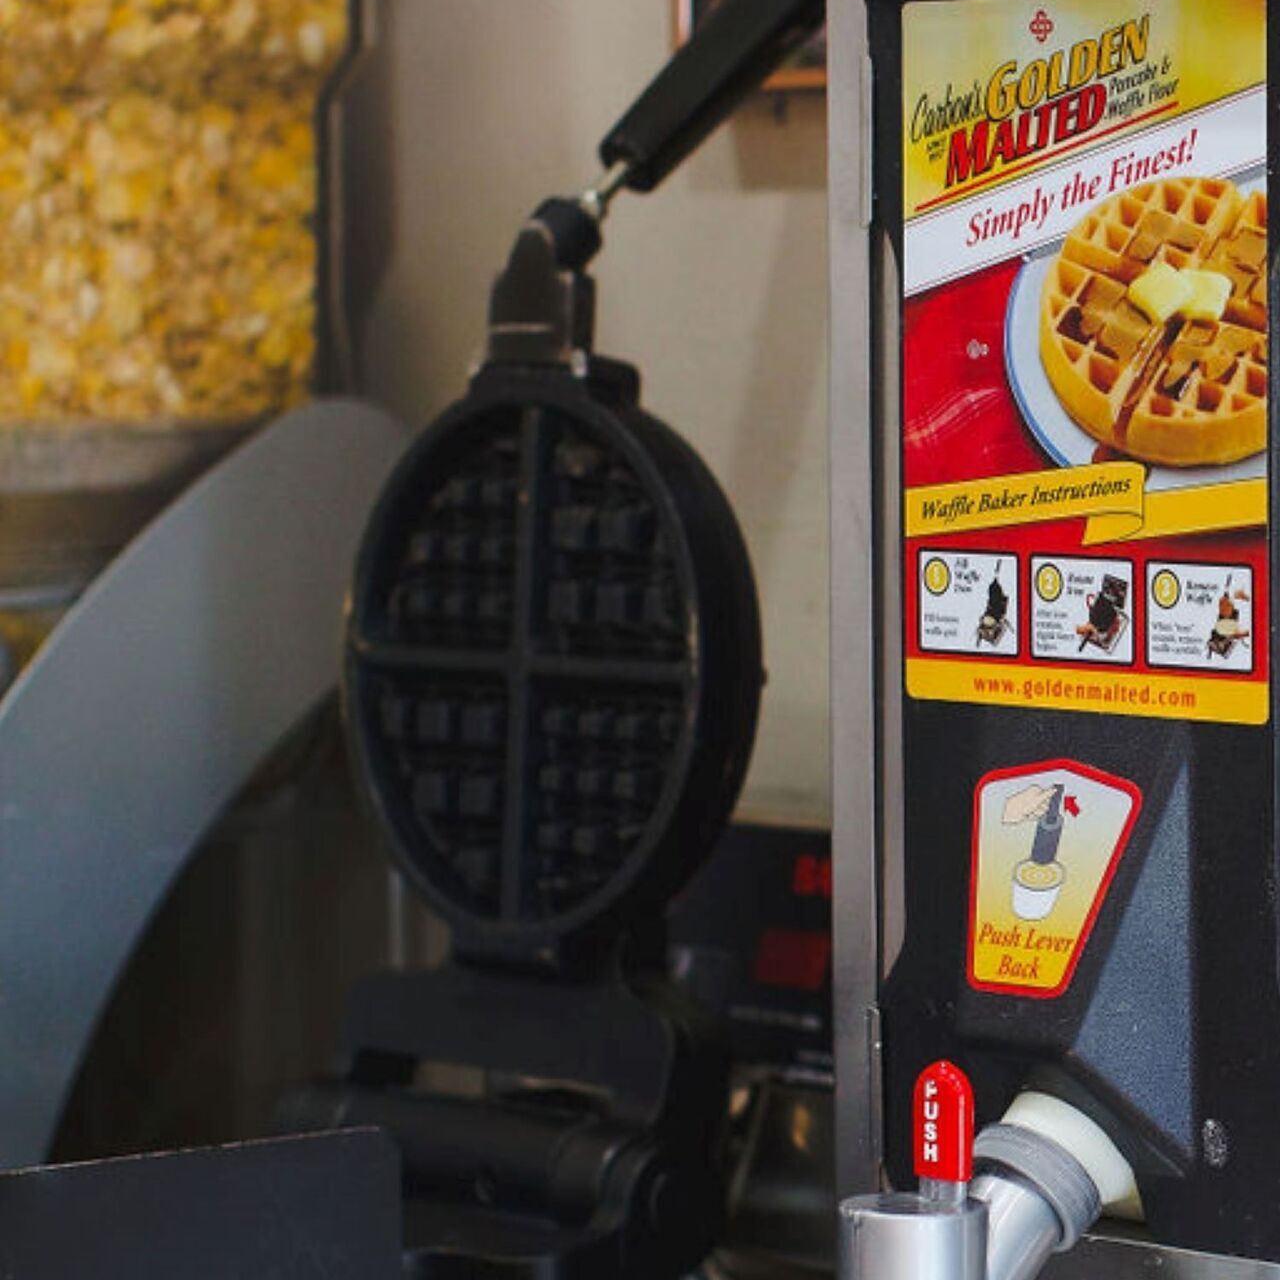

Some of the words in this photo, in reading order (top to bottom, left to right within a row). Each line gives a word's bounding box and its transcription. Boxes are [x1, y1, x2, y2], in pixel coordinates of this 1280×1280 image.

[986, 13, 1151, 121] GOLDEN
[945, 84, 1107, 188] MALTED
[966, 190, 1054, 247] Simply
[1060, 173, 1101, 211] the
[1108, 128, 1199, 193] Finest!
[921, 493, 976, 526] Waffle
[978, 488, 1027, 514] Baker
[1030, 476, 1133, 506] Instructions
[973, 676, 1198, 708] www.goldenmalted.com
[978, 922, 1022, 948] Push
[1025, 927, 1075, 952] Lever
[998, 955, 1041, 980] Back
[922, 1079, 939, 1162] PUSH
